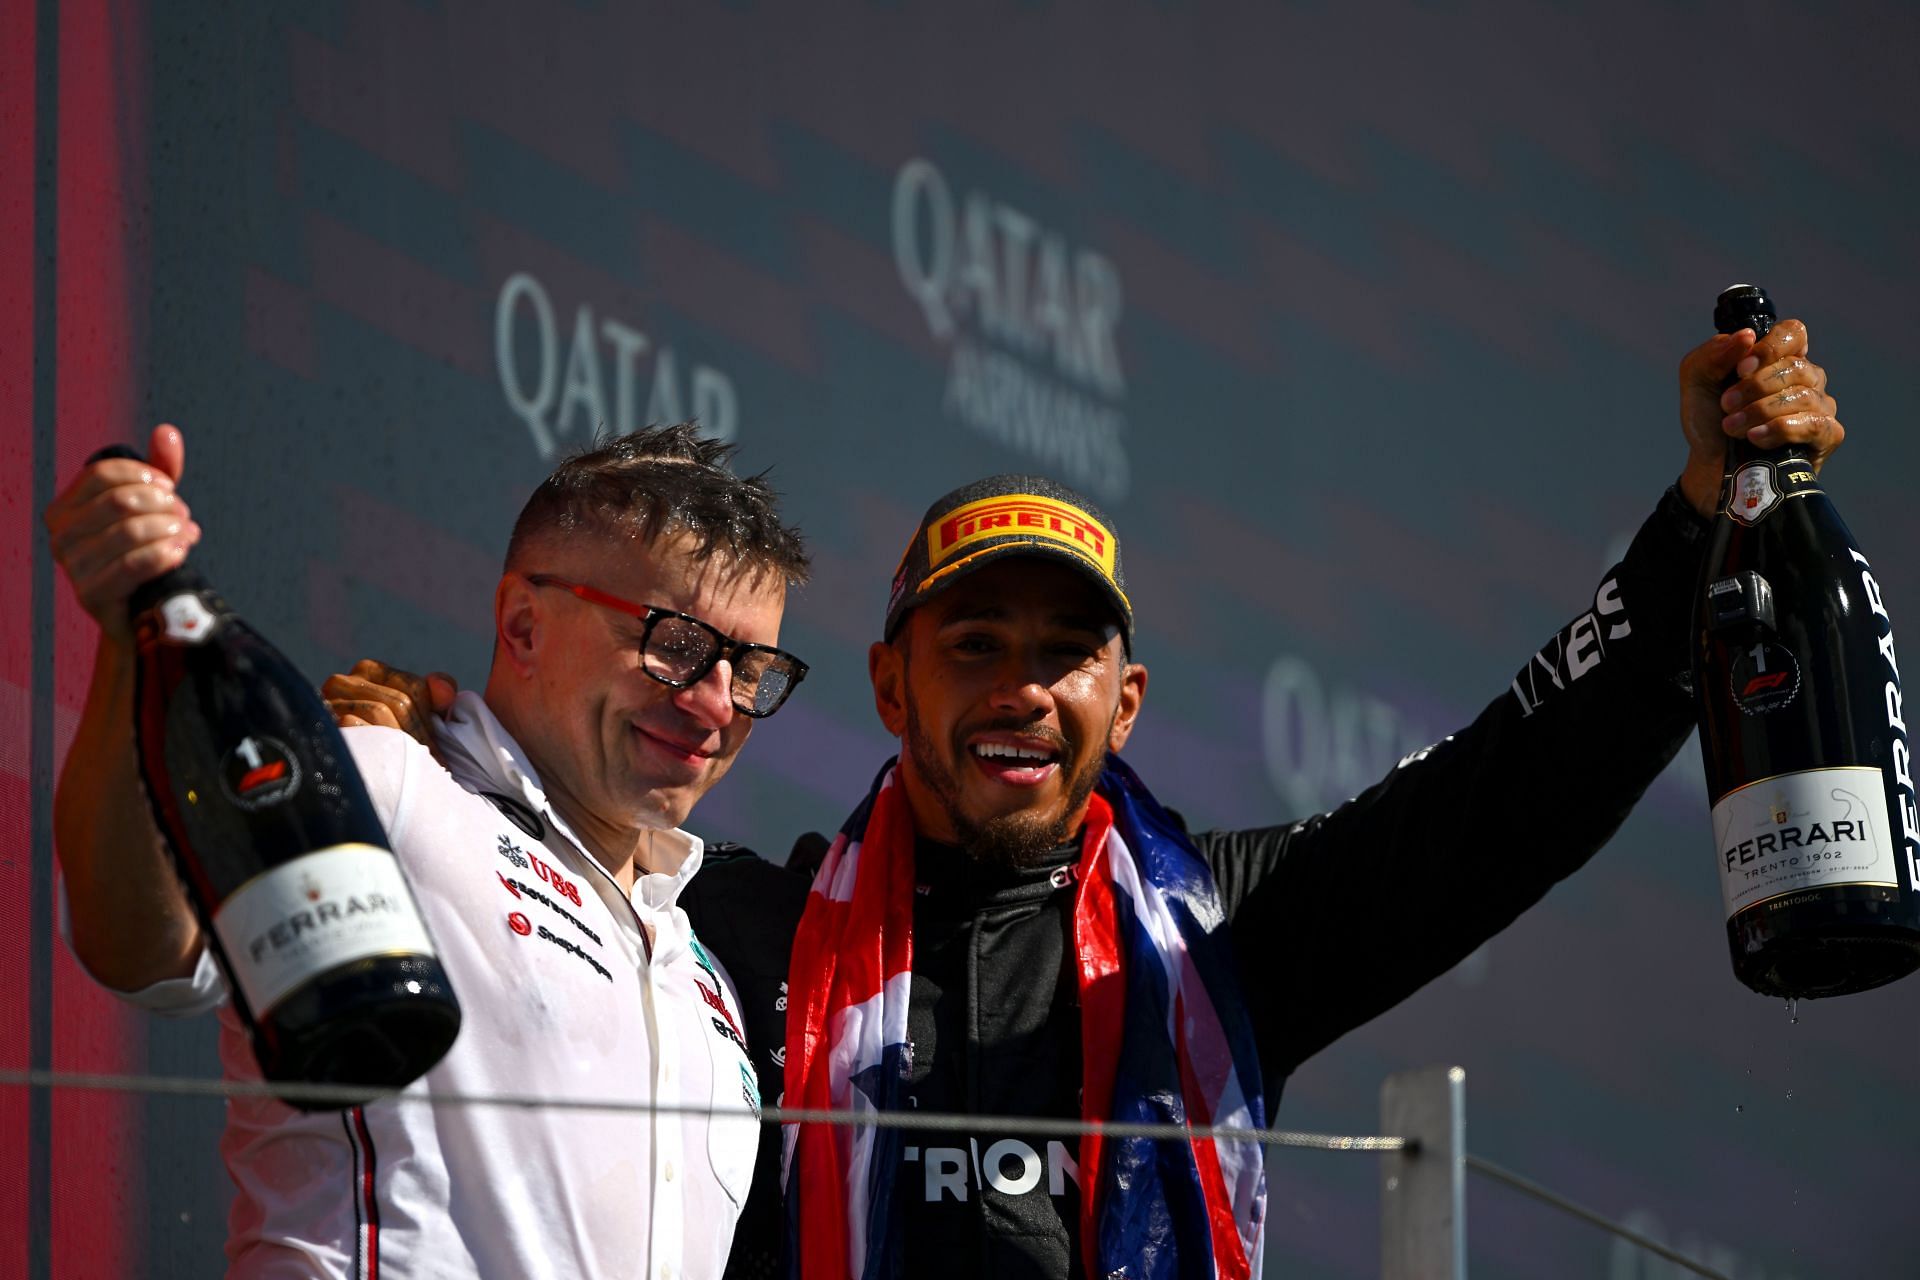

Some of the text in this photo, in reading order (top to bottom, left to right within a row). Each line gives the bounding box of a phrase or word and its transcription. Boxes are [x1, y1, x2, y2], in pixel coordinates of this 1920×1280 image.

[892, 157, 1123, 396] QATAR
[940, 501, 1105, 558] PIRELLI
[1262, 656, 1423, 816] QAT
[1849, 547, 1920, 893] FERRARI
[1726, 820, 1867, 873] FERRARI
[1744, 851, 1843, 880] TRENTO 1902
[527, 851, 582, 907] UBS
